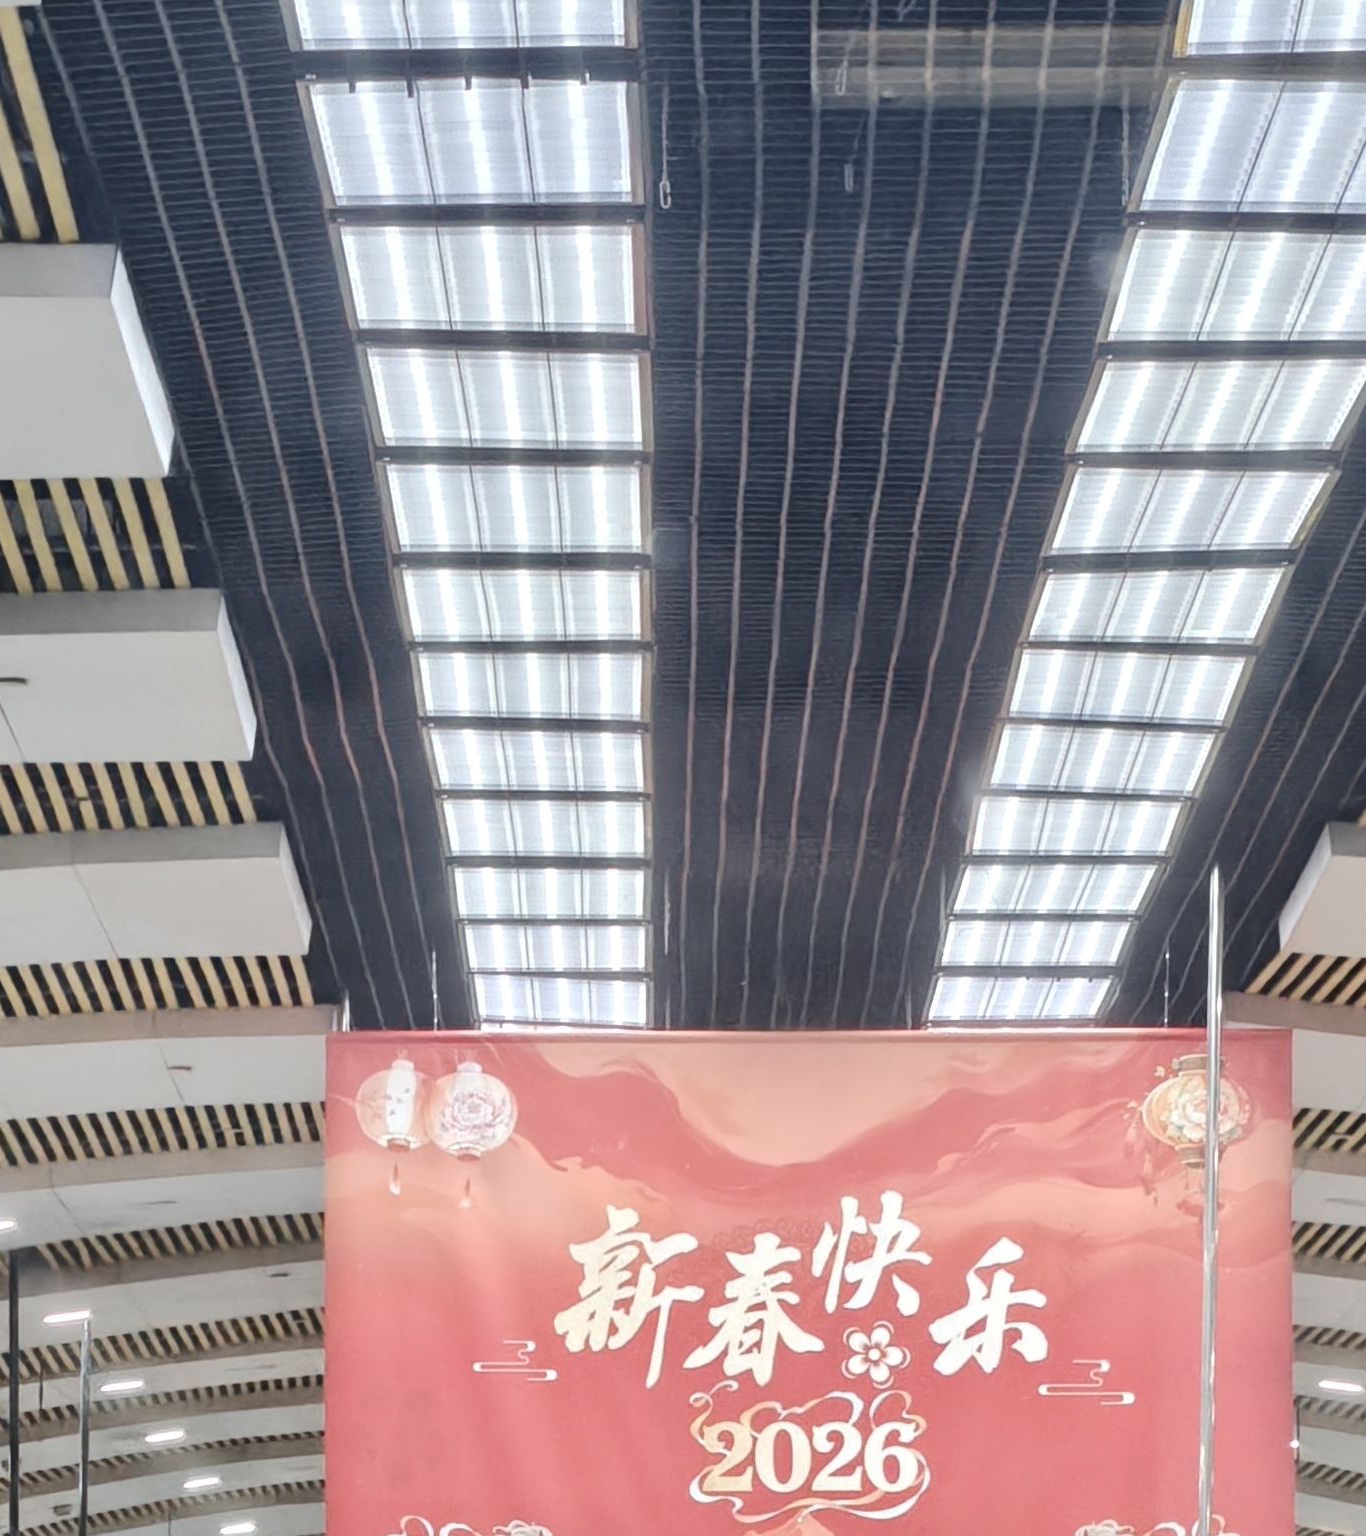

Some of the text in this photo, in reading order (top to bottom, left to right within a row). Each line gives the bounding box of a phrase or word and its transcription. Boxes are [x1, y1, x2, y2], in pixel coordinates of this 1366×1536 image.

[553, 1190, 1049, 1389] 新春快乐
[702, 1420, 919, 1494] 2026
